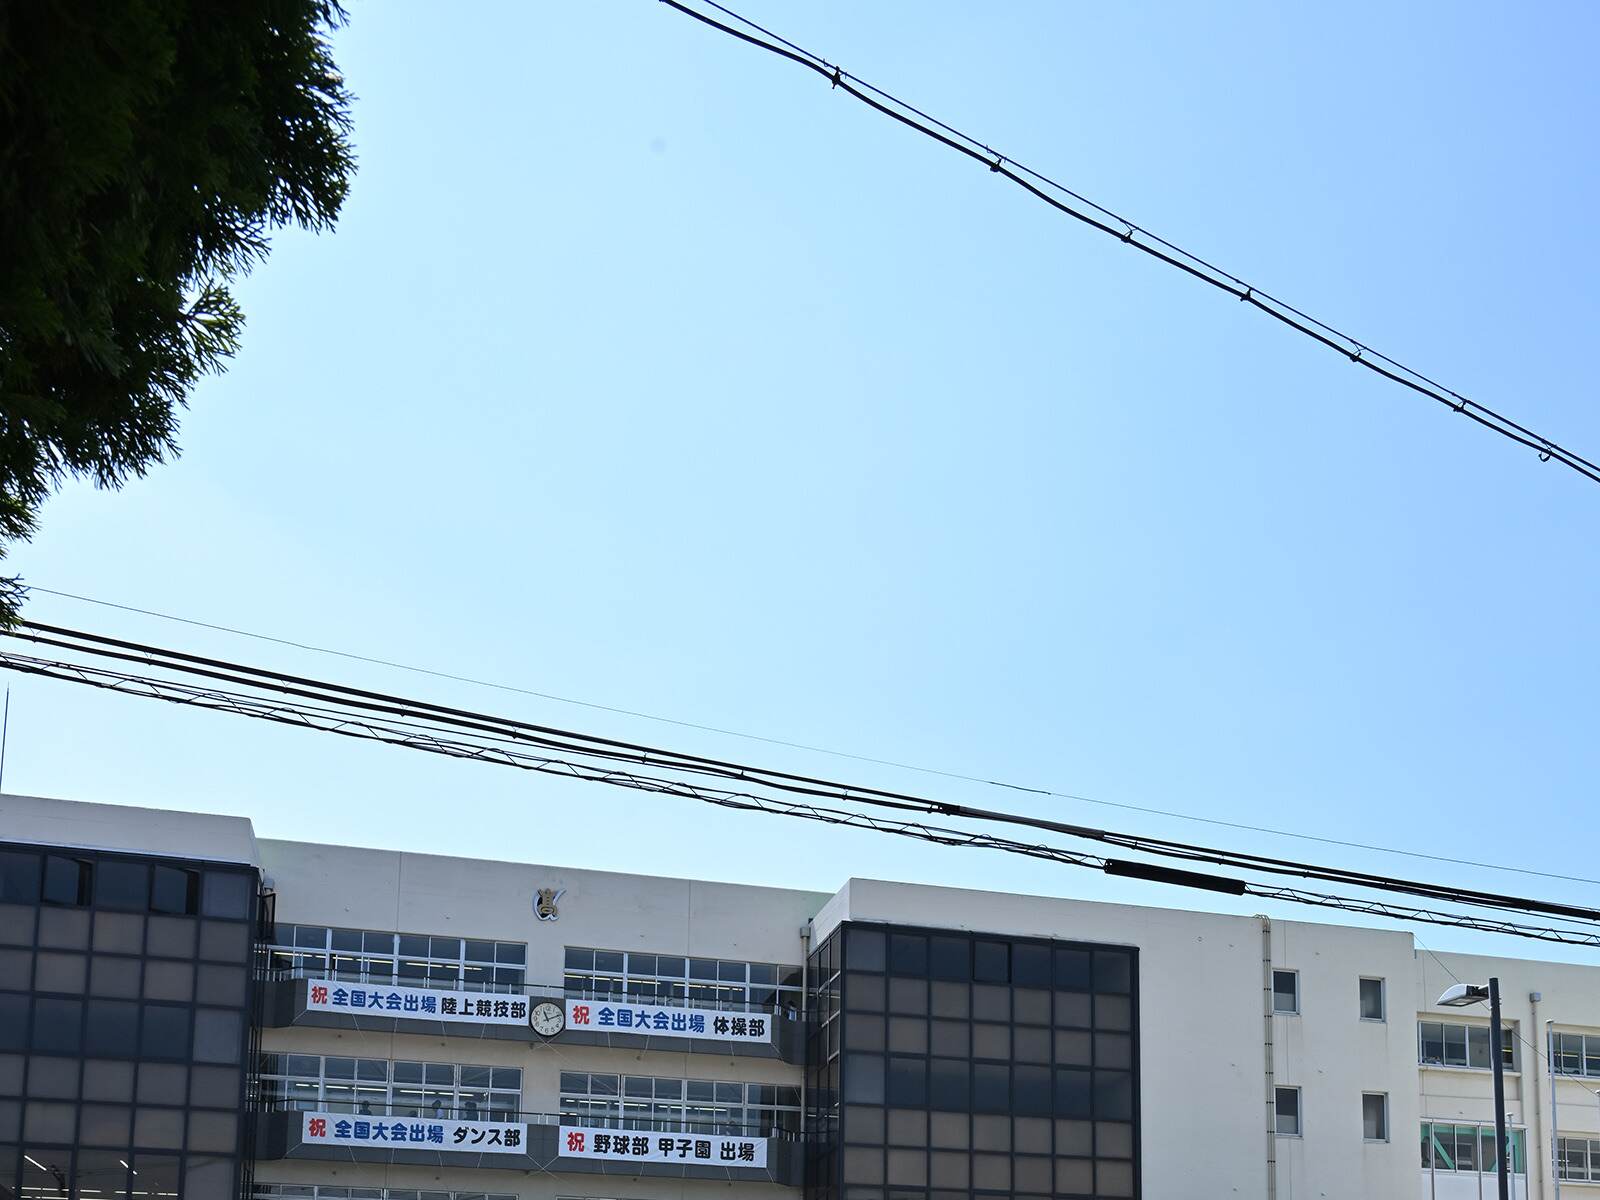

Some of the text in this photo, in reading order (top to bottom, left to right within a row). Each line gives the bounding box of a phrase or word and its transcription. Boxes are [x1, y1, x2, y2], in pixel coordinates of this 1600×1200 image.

[311, 985, 527, 1019] 祝 全国大会出場 陸上競技部
[572, 1005, 765, 1037] 祝 全国大会出場 体操部
[308, 1117, 521, 1147] 祝 全国大会出場 ダンス部
[567, 1132, 755, 1161] 祝 野球部 甲子園 出場
